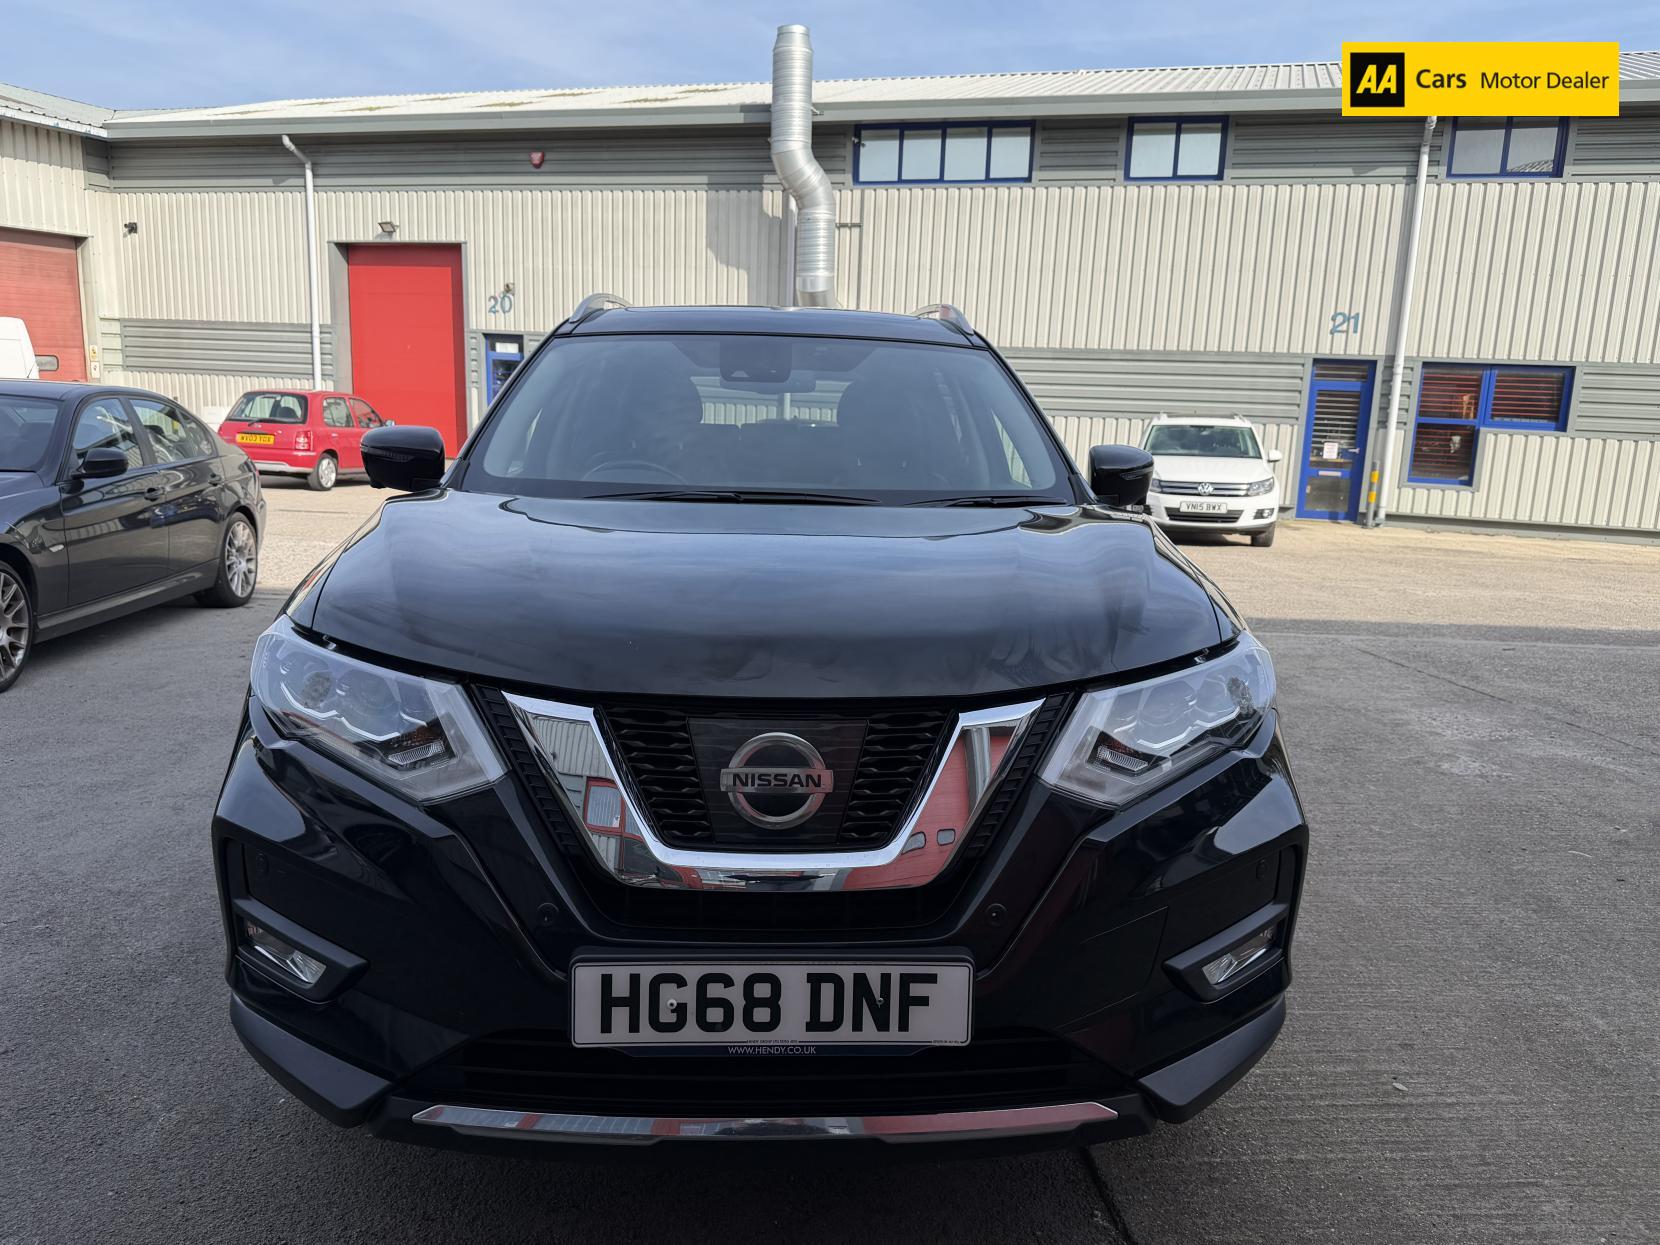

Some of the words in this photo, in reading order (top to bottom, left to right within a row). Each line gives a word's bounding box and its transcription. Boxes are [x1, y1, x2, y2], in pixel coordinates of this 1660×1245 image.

[488, 294, 512, 314] 20
[1330, 312, 1360, 335] 21
[732, 773, 822, 788] NISSAN
[600, 972, 782, 1034] HG68
[805, 972, 938, 1033] DNF
[727, 1045, 817, 1055] WWW.HENDY.CO.UK
